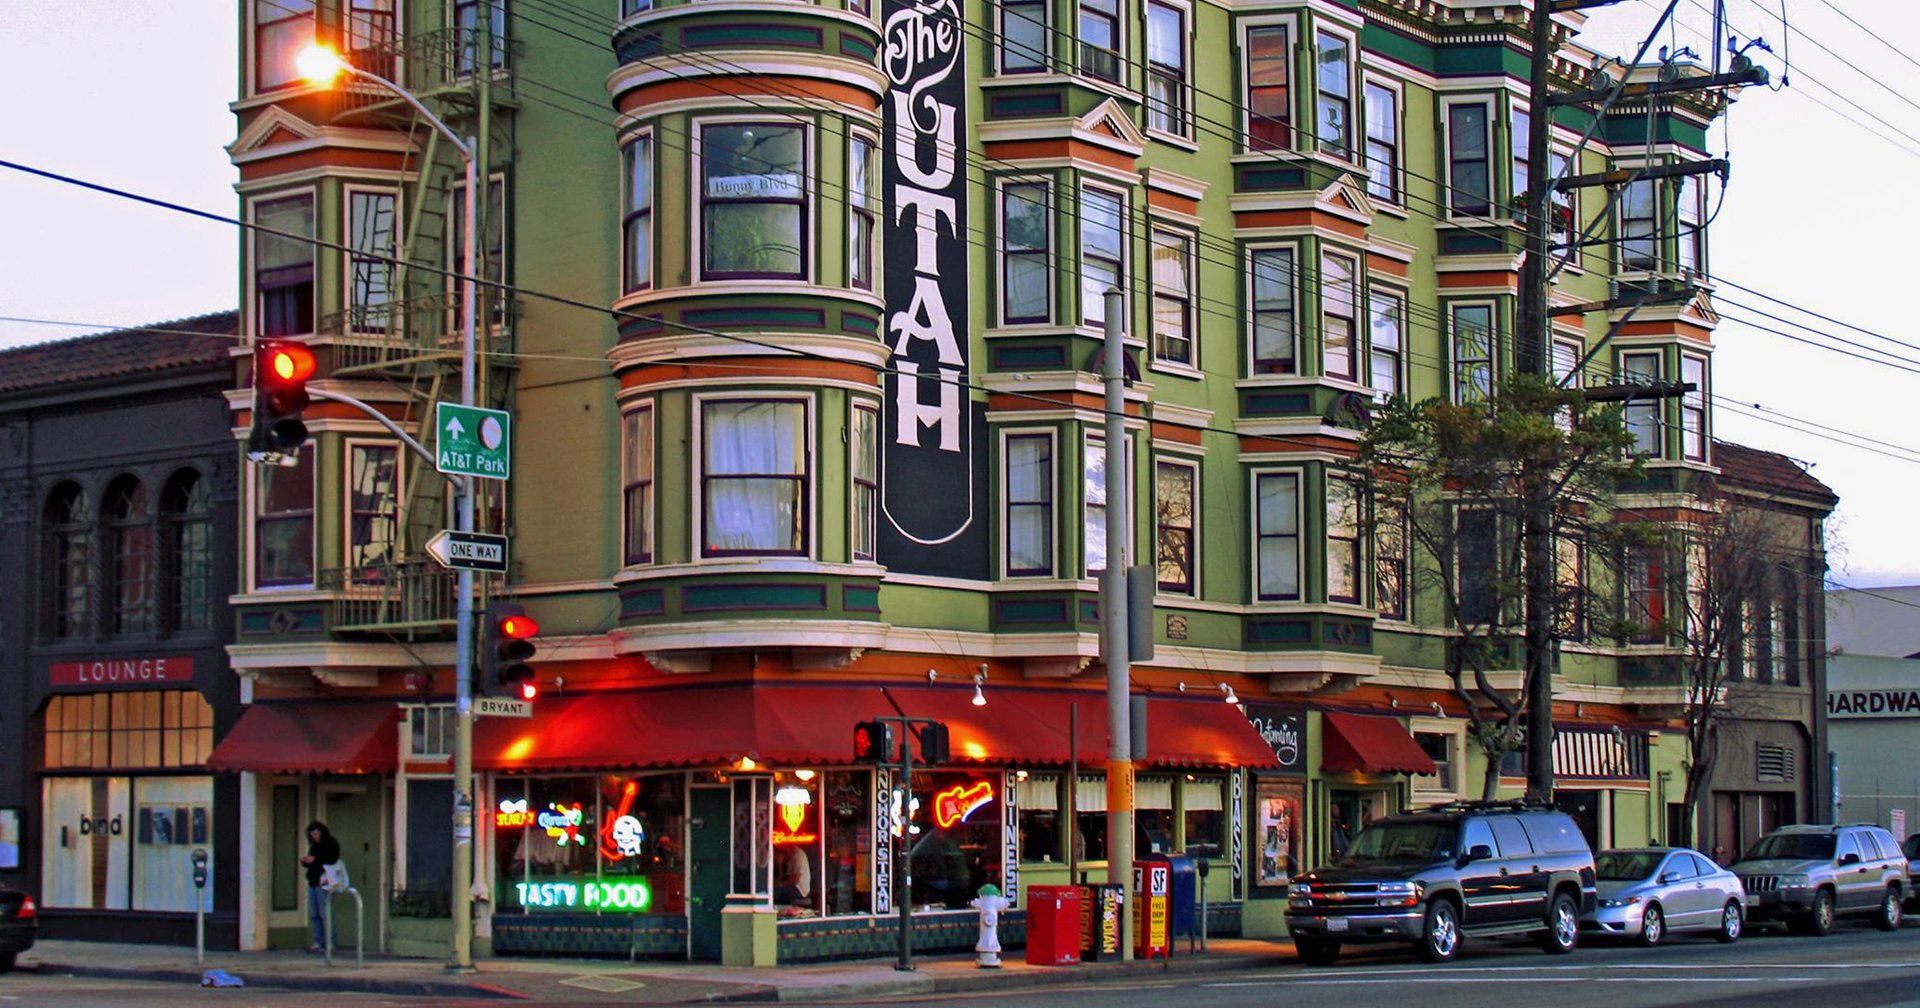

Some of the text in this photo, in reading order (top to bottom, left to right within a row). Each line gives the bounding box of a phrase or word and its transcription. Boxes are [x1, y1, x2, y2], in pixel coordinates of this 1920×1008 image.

[884, 0, 961, 86] The
[715, 178, 788, 193] Bunny Blvd
[890, 89, 965, 452] UTAH
[441, 451, 505, 473] AT&T Park
[451, 543, 498, 560] ONE WAY
[79, 659, 167, 682] LOUNGE
[481, 701, 523, 714] BRYANT
[1232, 773, 1241, 879] BASS
[1153, 870, 1165, 891] SF
[516, 883, 648, 907] TASTY FOOD
[1103, 889, 1115, 954] UADIAN
